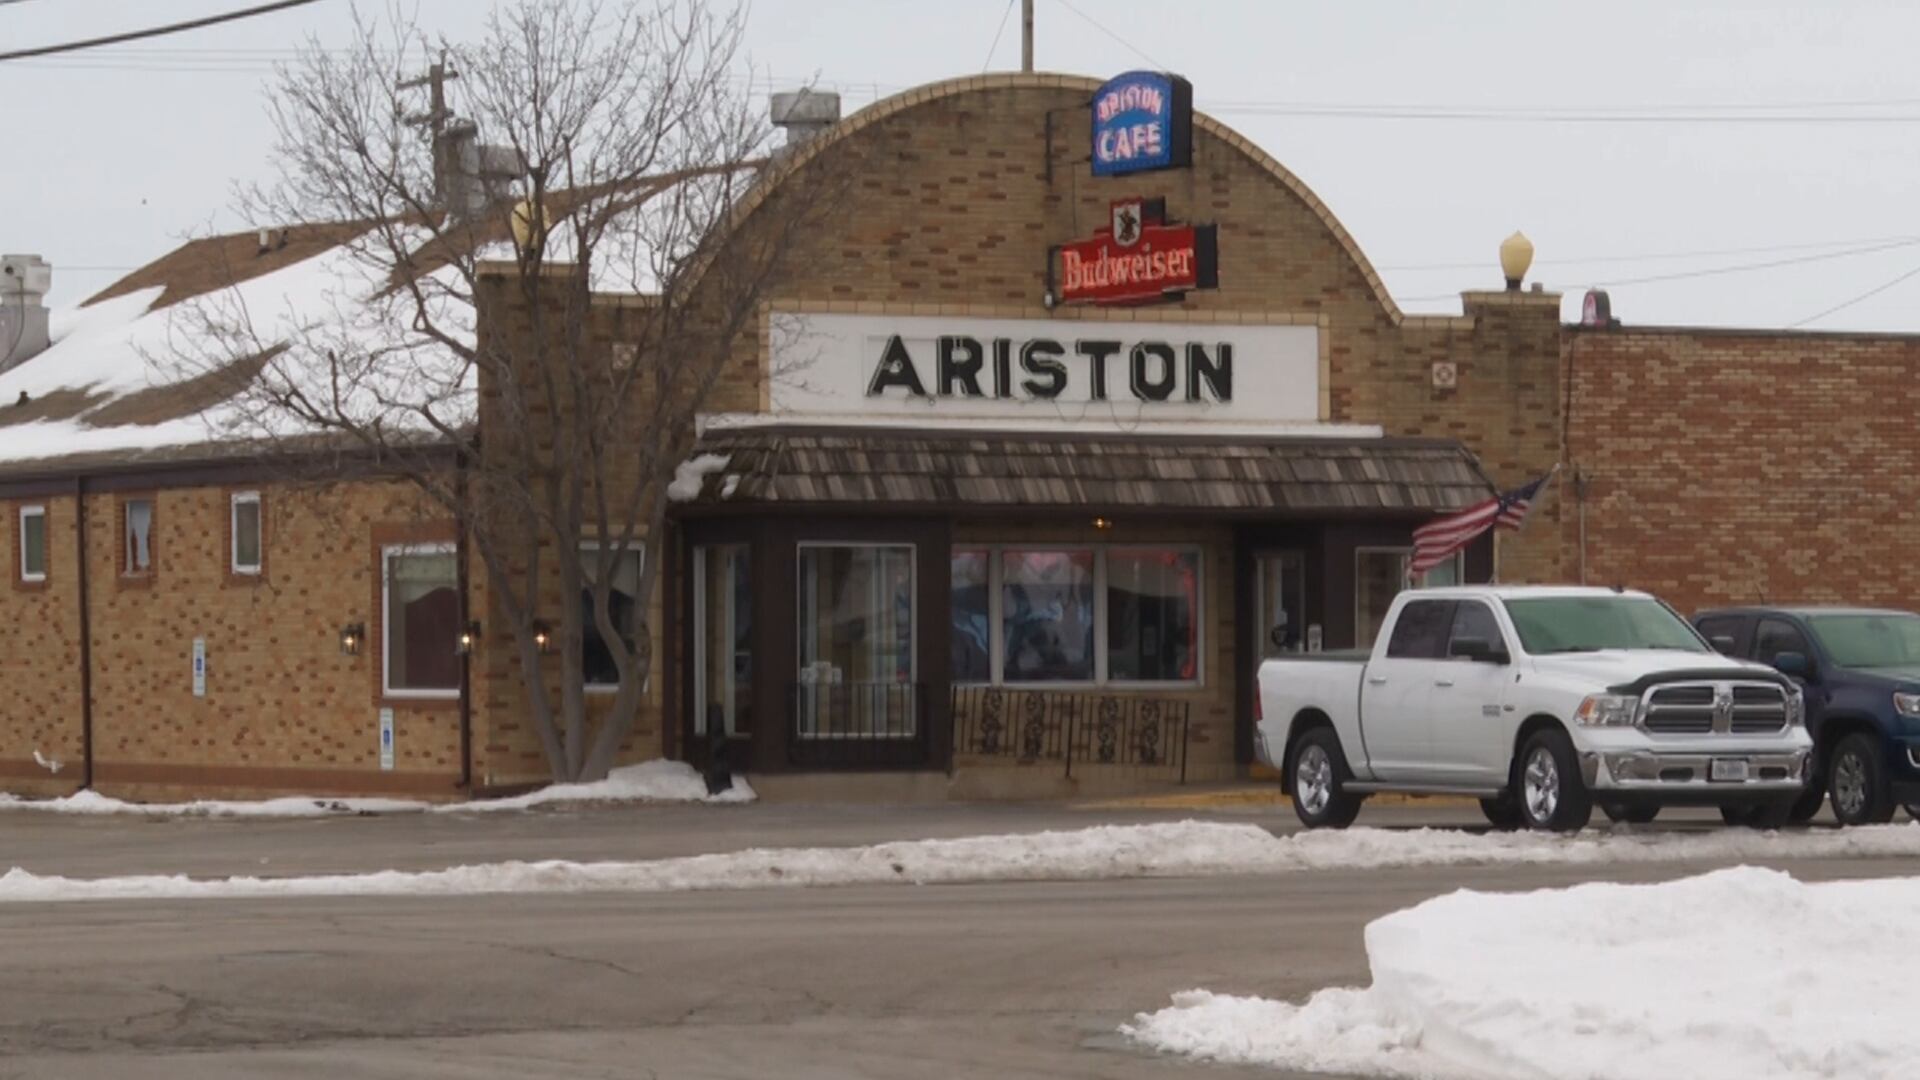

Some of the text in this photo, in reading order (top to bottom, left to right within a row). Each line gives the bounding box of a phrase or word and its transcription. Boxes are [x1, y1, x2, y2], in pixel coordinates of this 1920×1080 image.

[1097, 122, 1162, 162] CAFE
[1061, 243, 1195, 292] Budweiser
[865, 334, 1233, 403] ARISTON
